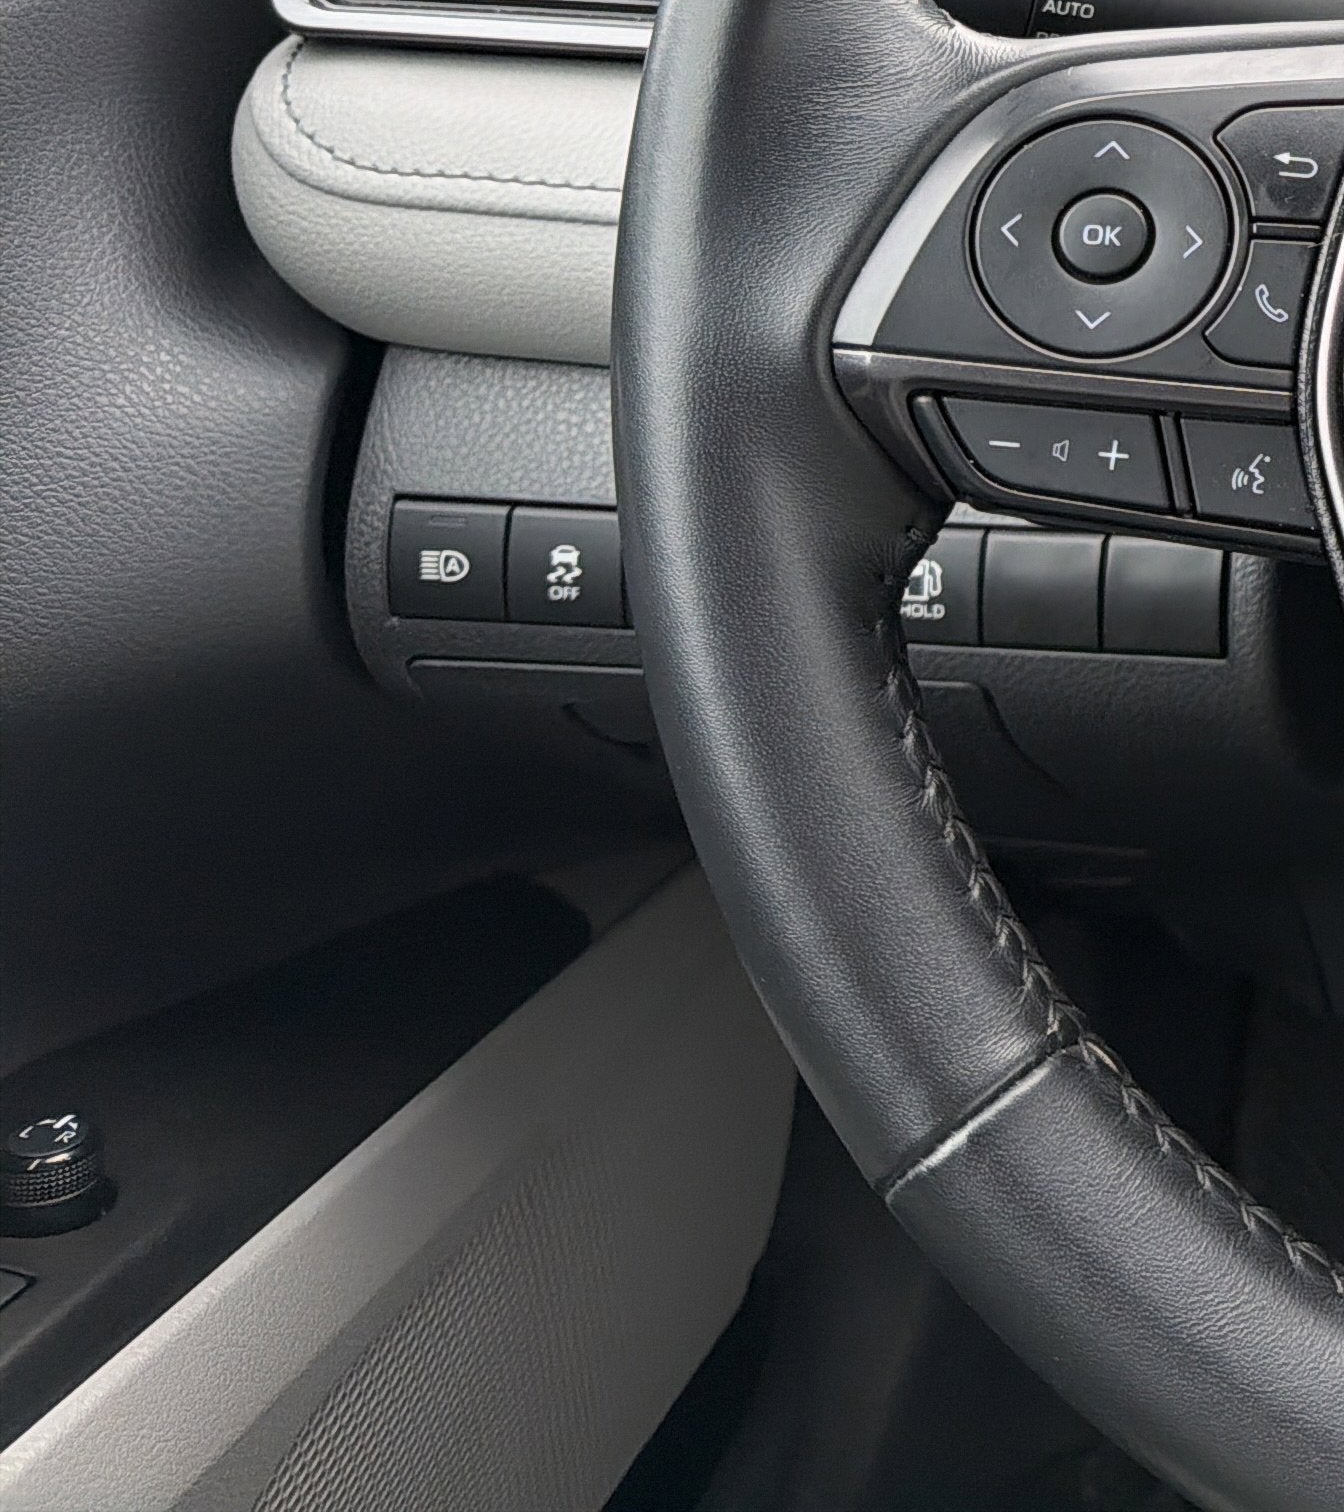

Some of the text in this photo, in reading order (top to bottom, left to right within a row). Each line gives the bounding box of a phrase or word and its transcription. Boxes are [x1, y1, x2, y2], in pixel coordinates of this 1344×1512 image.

[1081, 223, 1122, 248] OK
[546, 585, 581, 602] OFF
[899, 603, 946, 620] HOLD
[53, 1130, 77, 1143] R
